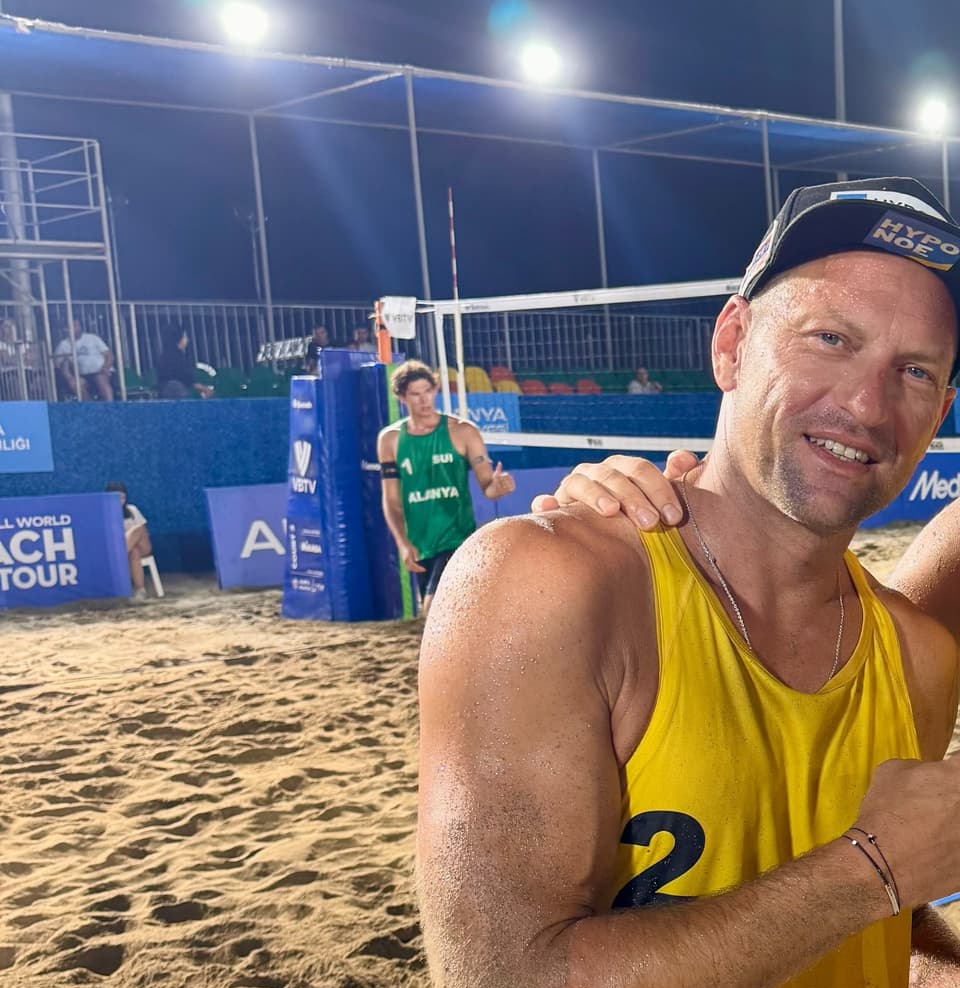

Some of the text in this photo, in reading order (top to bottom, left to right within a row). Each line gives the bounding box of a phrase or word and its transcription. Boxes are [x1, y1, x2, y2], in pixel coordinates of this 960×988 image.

[872, 228, 934, 258] NOE
[880, 218, 960, 256] HYPO
[401, 458, 413, 476] 1
[432, 453, 454, 465] SUI
[292, 477, 317, 495] VBTV
[16, 514, 72, 529] WORLD
[0, 563, 79, 592] TOUR
[611, 810, 706, 909] 2
